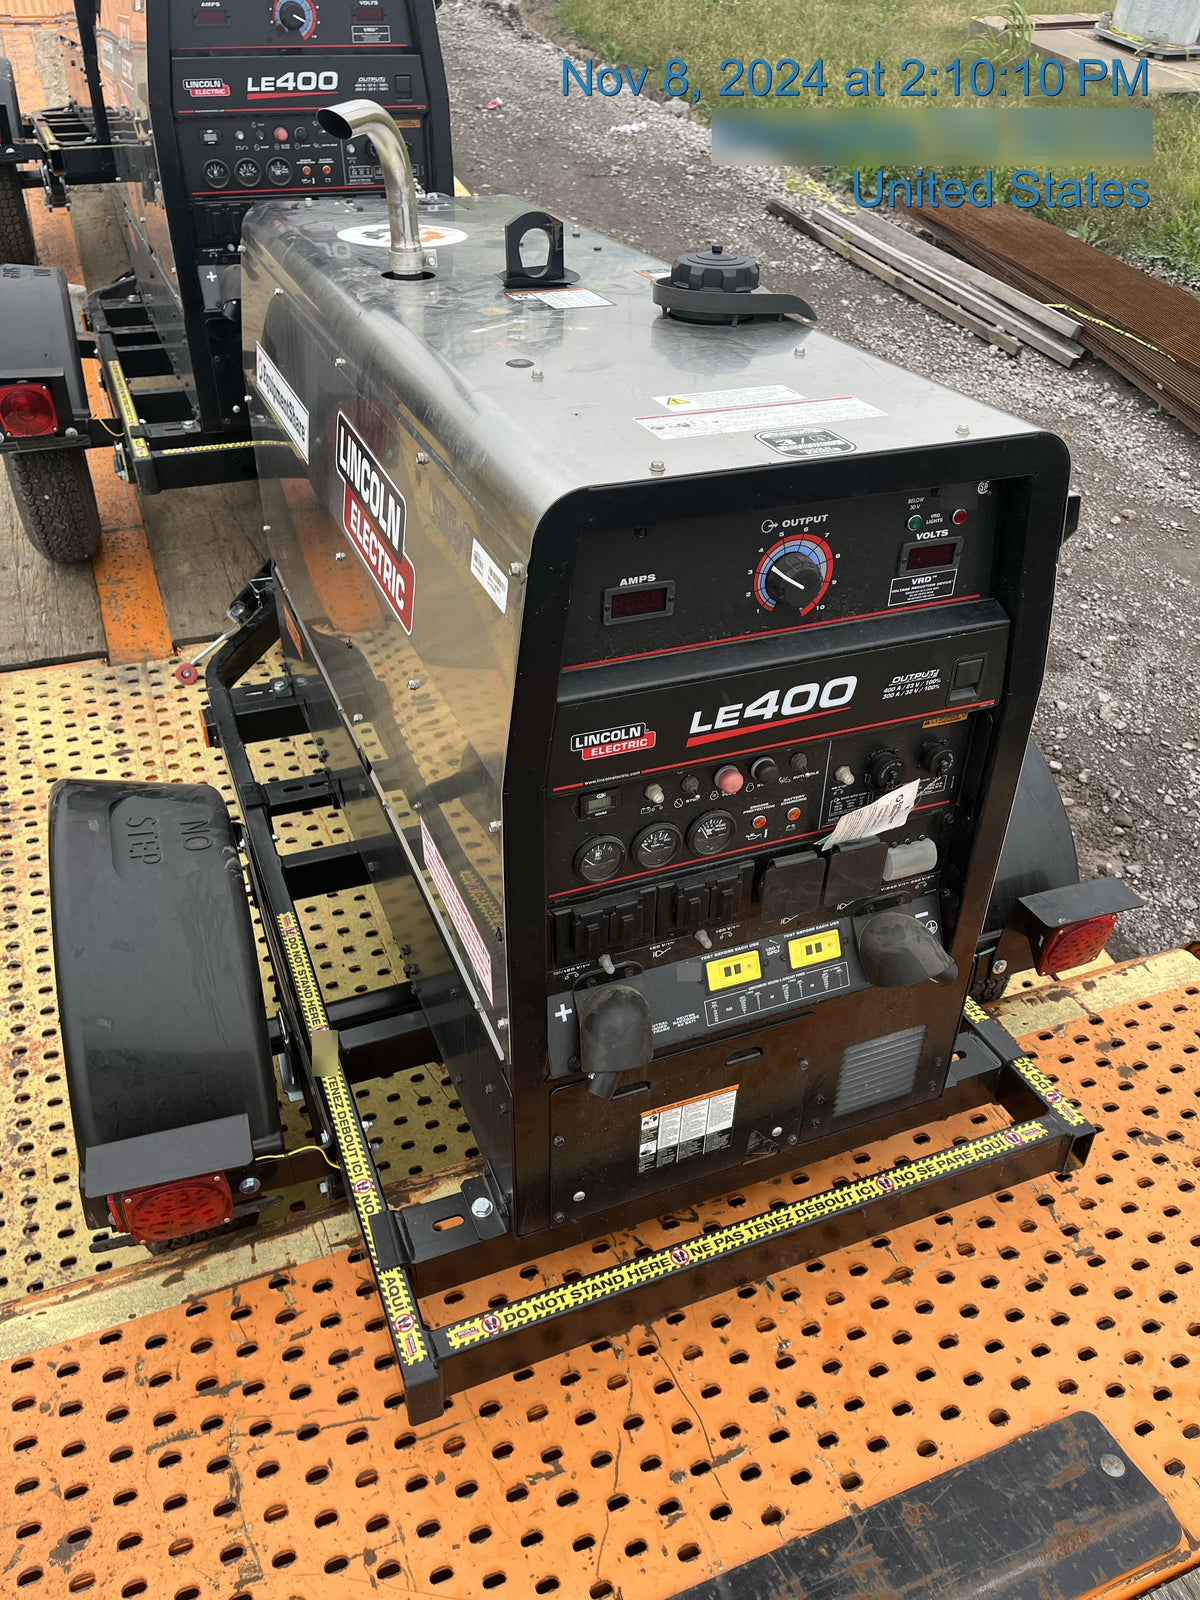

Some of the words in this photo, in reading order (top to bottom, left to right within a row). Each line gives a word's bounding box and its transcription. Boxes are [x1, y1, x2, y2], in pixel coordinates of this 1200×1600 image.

[185, 80, 221, 89] LINCOLN
[247, 71, 339, 92] LE400
[339, 425, 401, 551] LINCOLN
[782, 514, 829, 528] OUTPUT
[925, 517, 944, 525] LIGHTS
[916, 529, 949, 540] VOLTS
[350, 498, 406, 611] ELECTRIC
[619, 573, 657, 586] AMPS
[689, 675, 858, 735] LE400
[575, 725, 641, 749] LINCOLN
[591, 738, 648, 756] ELECTRIC
[584, 770, 641, 786] www.lincolnelectric.com
[742, 804, 776, 814] PROTECTION
[126, 816, 162, 865] STEP
[179, 820, 213, 851] NO
[796, 926, 816, 936] BEFORE
[288, 936, 299, 950] DO
[700, 953, 714, 961] TEST
[714, 949, 734, 957] BEFORE
[734, 944, 749, 952] EACH
[292, 951, 305, 968] NOT
[297, 968, 313, 999] STAND
[306, 1000, 321, 1026] HERE
[1031, 1073, 1049, 1090] DO
[337, 1111, 359, 1161] DEBOUT
[350, 1160, 364, 1178] ICI
[894, 1170, 916, 1184] NO
[918, 1164, 936, 1175] SE
[937, 1151, 973, 1170] PARE
[361, 1195, 376, 1215] NO
[690, 1242, 713, 1257] NE
[715, 1230, 744, 1247] PAS
[746, 1213, 794, 1236] TENEZ
[795, 1194, 854, 1218] DEBOUT
[856, 1185, 876, 1198] ICI
[503, 1308, 530, 1324] DO
[532, 1295, 566, 1313] NOT
[570, 1273, 625, 1300] STAND
[628, 1258, 670, 1279] HERE
